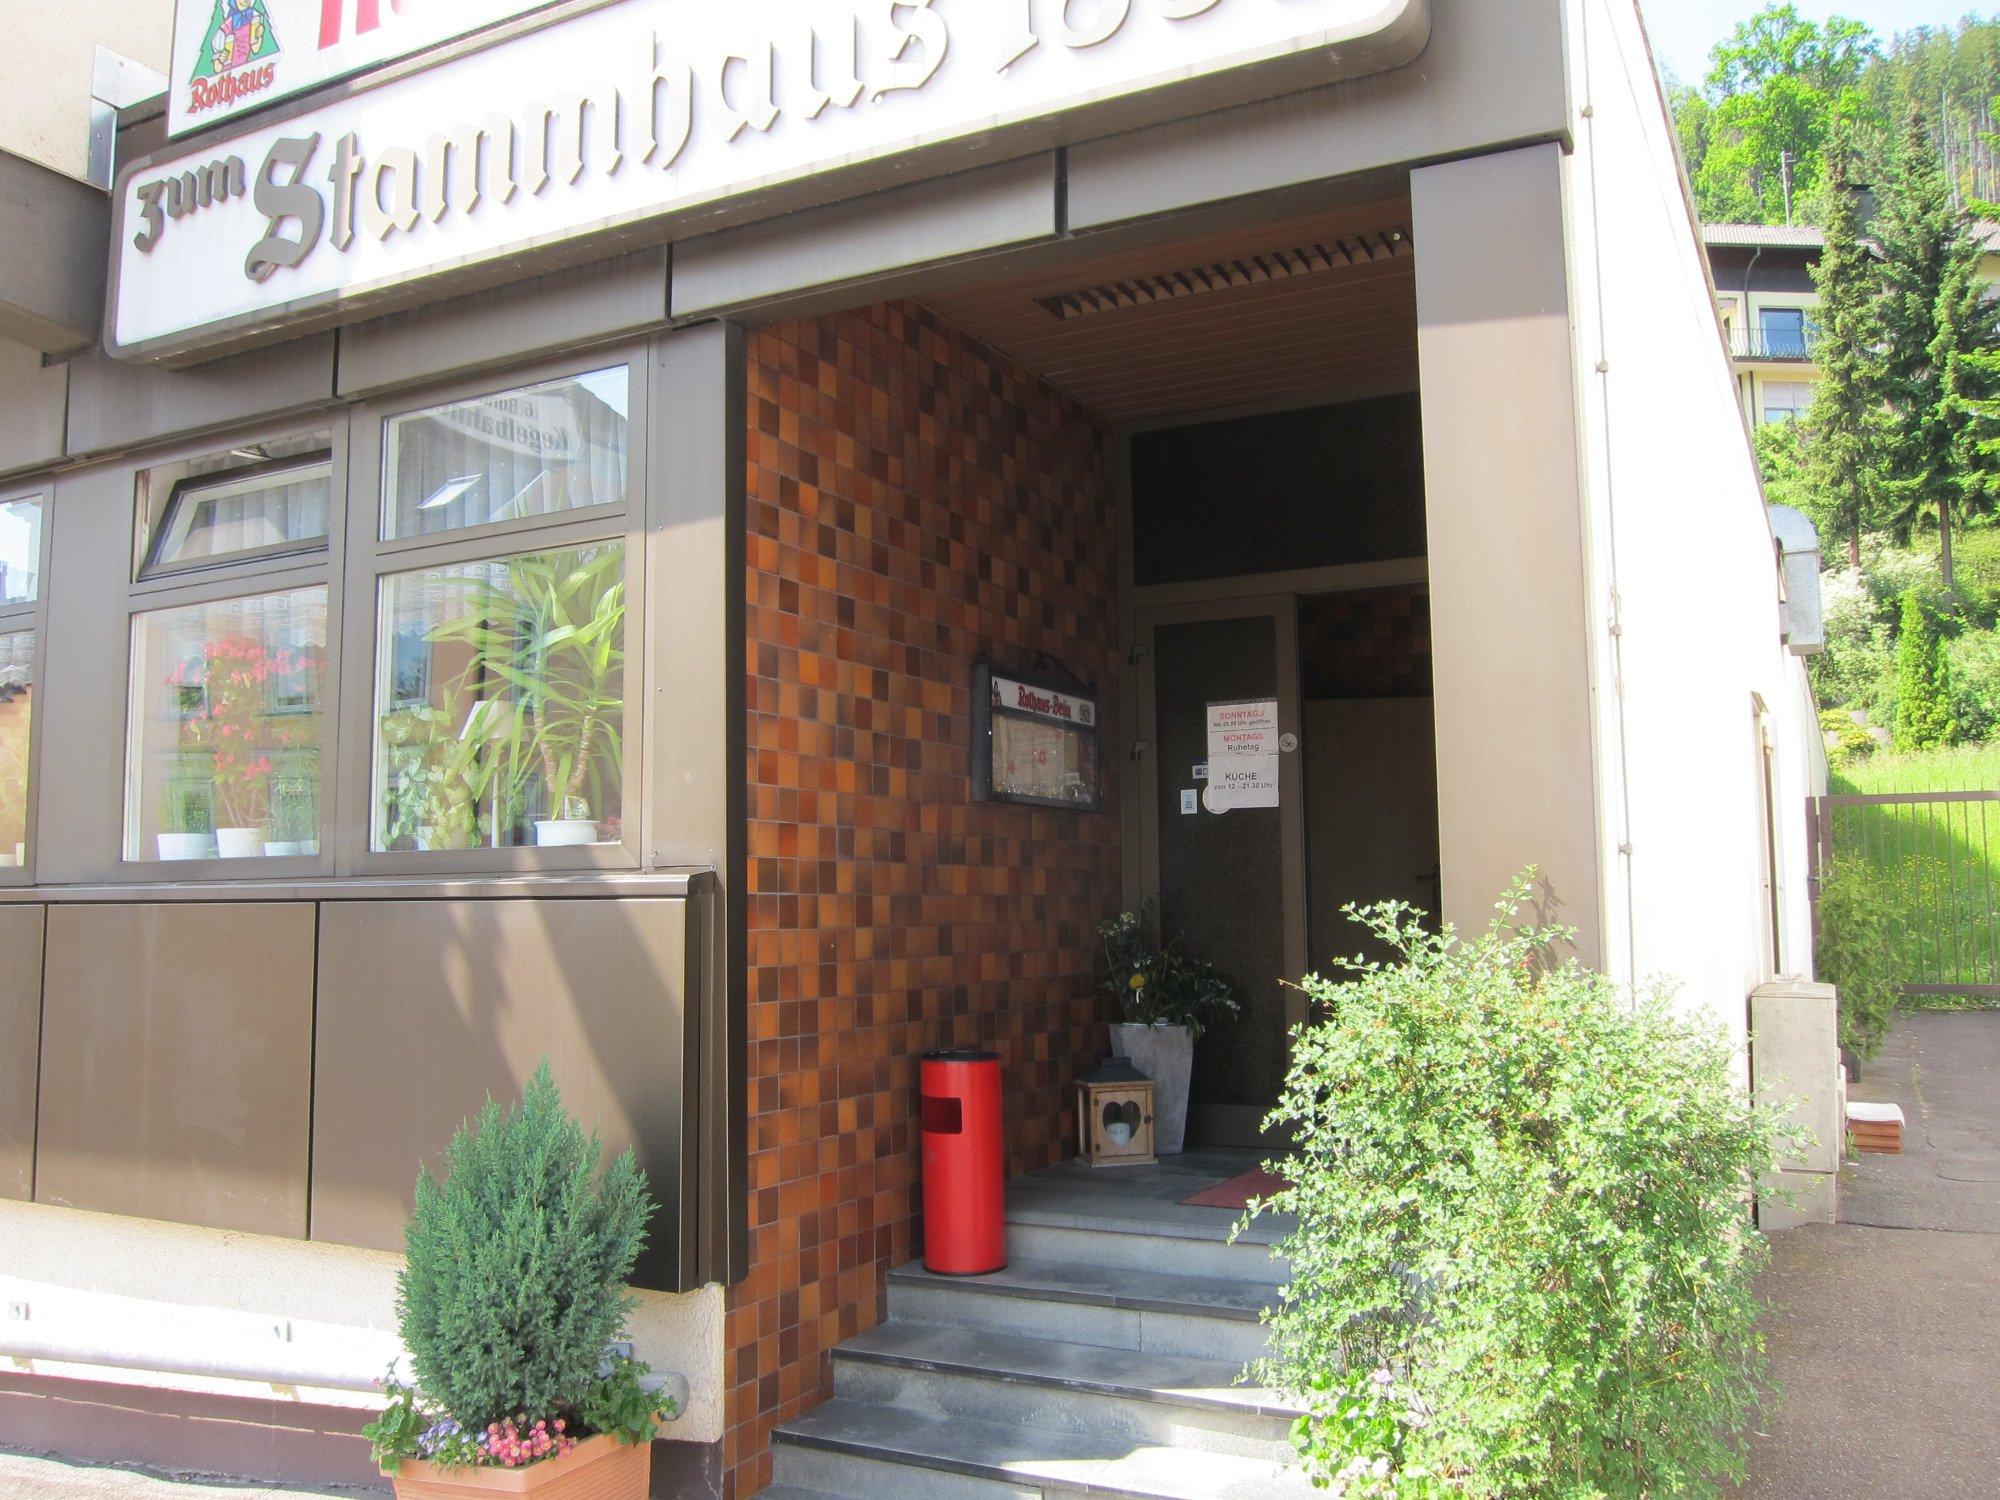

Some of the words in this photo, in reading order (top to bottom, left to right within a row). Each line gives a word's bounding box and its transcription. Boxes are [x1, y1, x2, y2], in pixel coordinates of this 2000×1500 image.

[187, 62, 276, 114] Rothaus
[244, 0, 950, 284] Stammhaus
[1219, 709, 1264, 720] SONNTAGS
[1223, 732, 1264, 742] MONTAGS
[1227, 744, 1260, 752] Ruhetag
